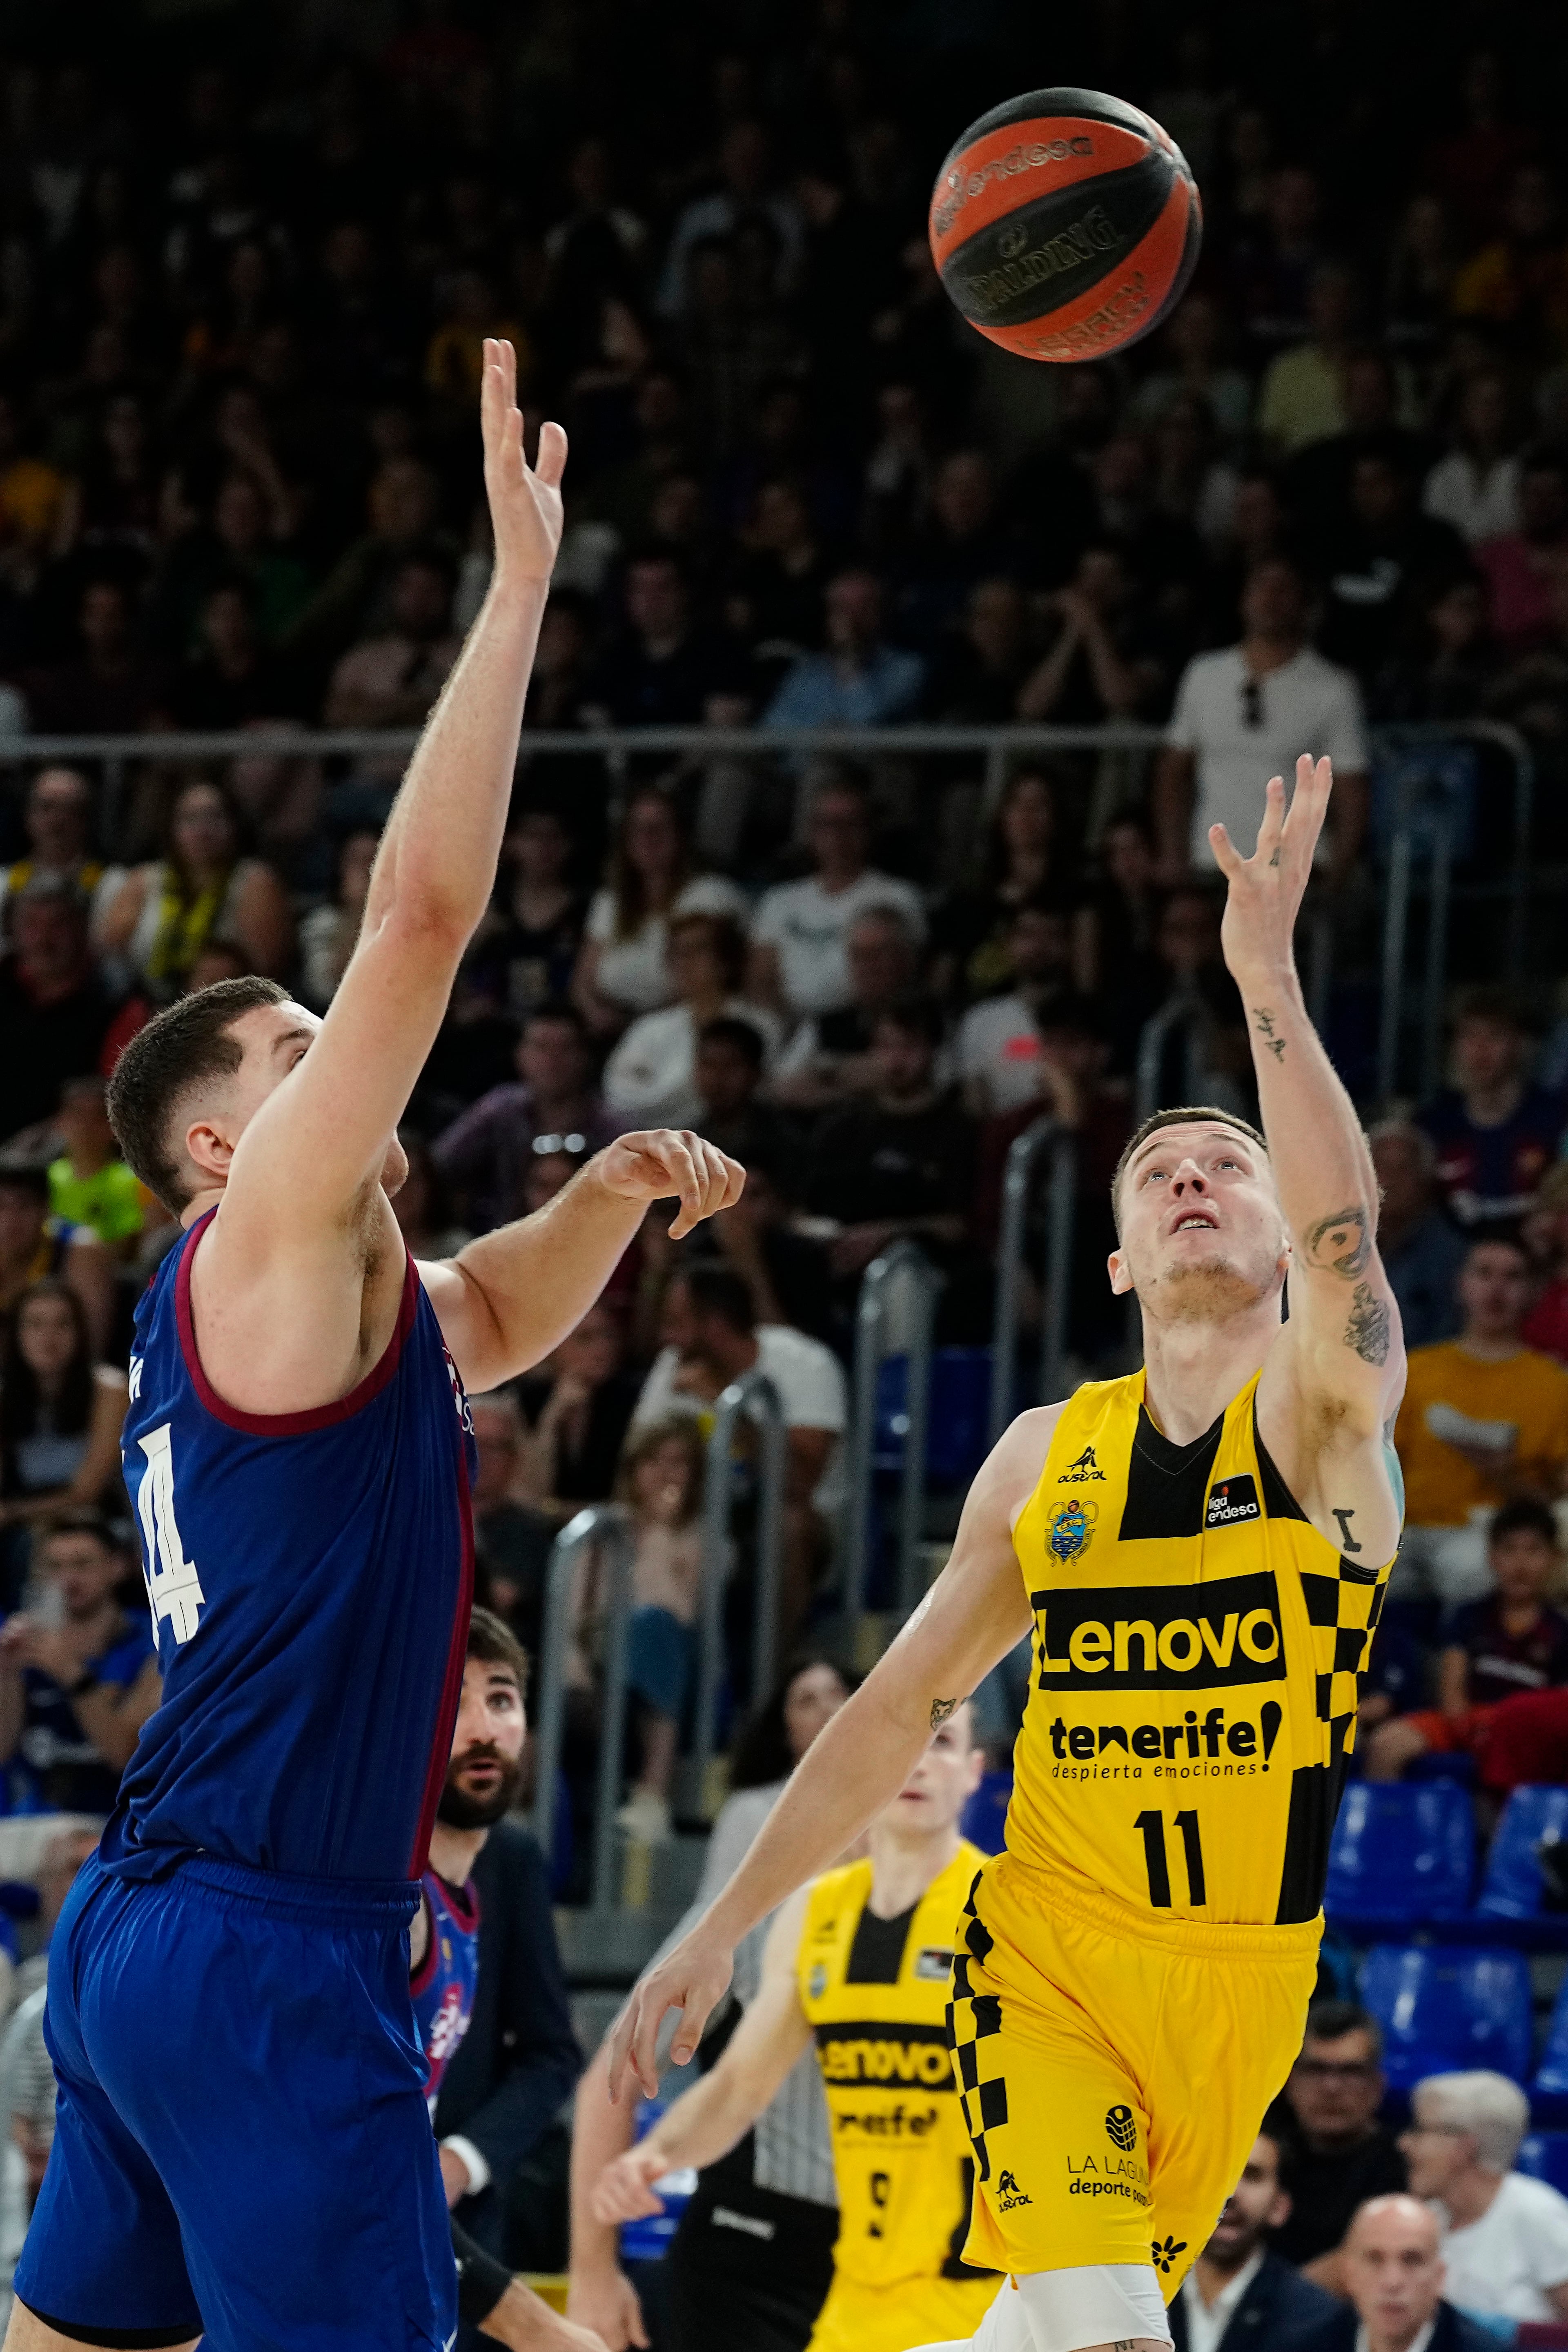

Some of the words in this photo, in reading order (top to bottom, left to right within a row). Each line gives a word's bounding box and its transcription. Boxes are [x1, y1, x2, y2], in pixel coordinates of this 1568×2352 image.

[1208, 1497, 1227, 1510] liga
[1208, 1503, 1258, 1522] endesa
[1036, 1608, 1279, 1673] Lenovo
[1049, 1701, 1282, 1773] tenerife!
[1052, 1763, 1142, 1782] despierta
[1154, 1762, 1256, 1779] emociones
[1133, 1809, 1206, 1908] 11
[1067, 2156, 1098, 2173] LA
[1070, 2178, 1131, 2197] deporte
